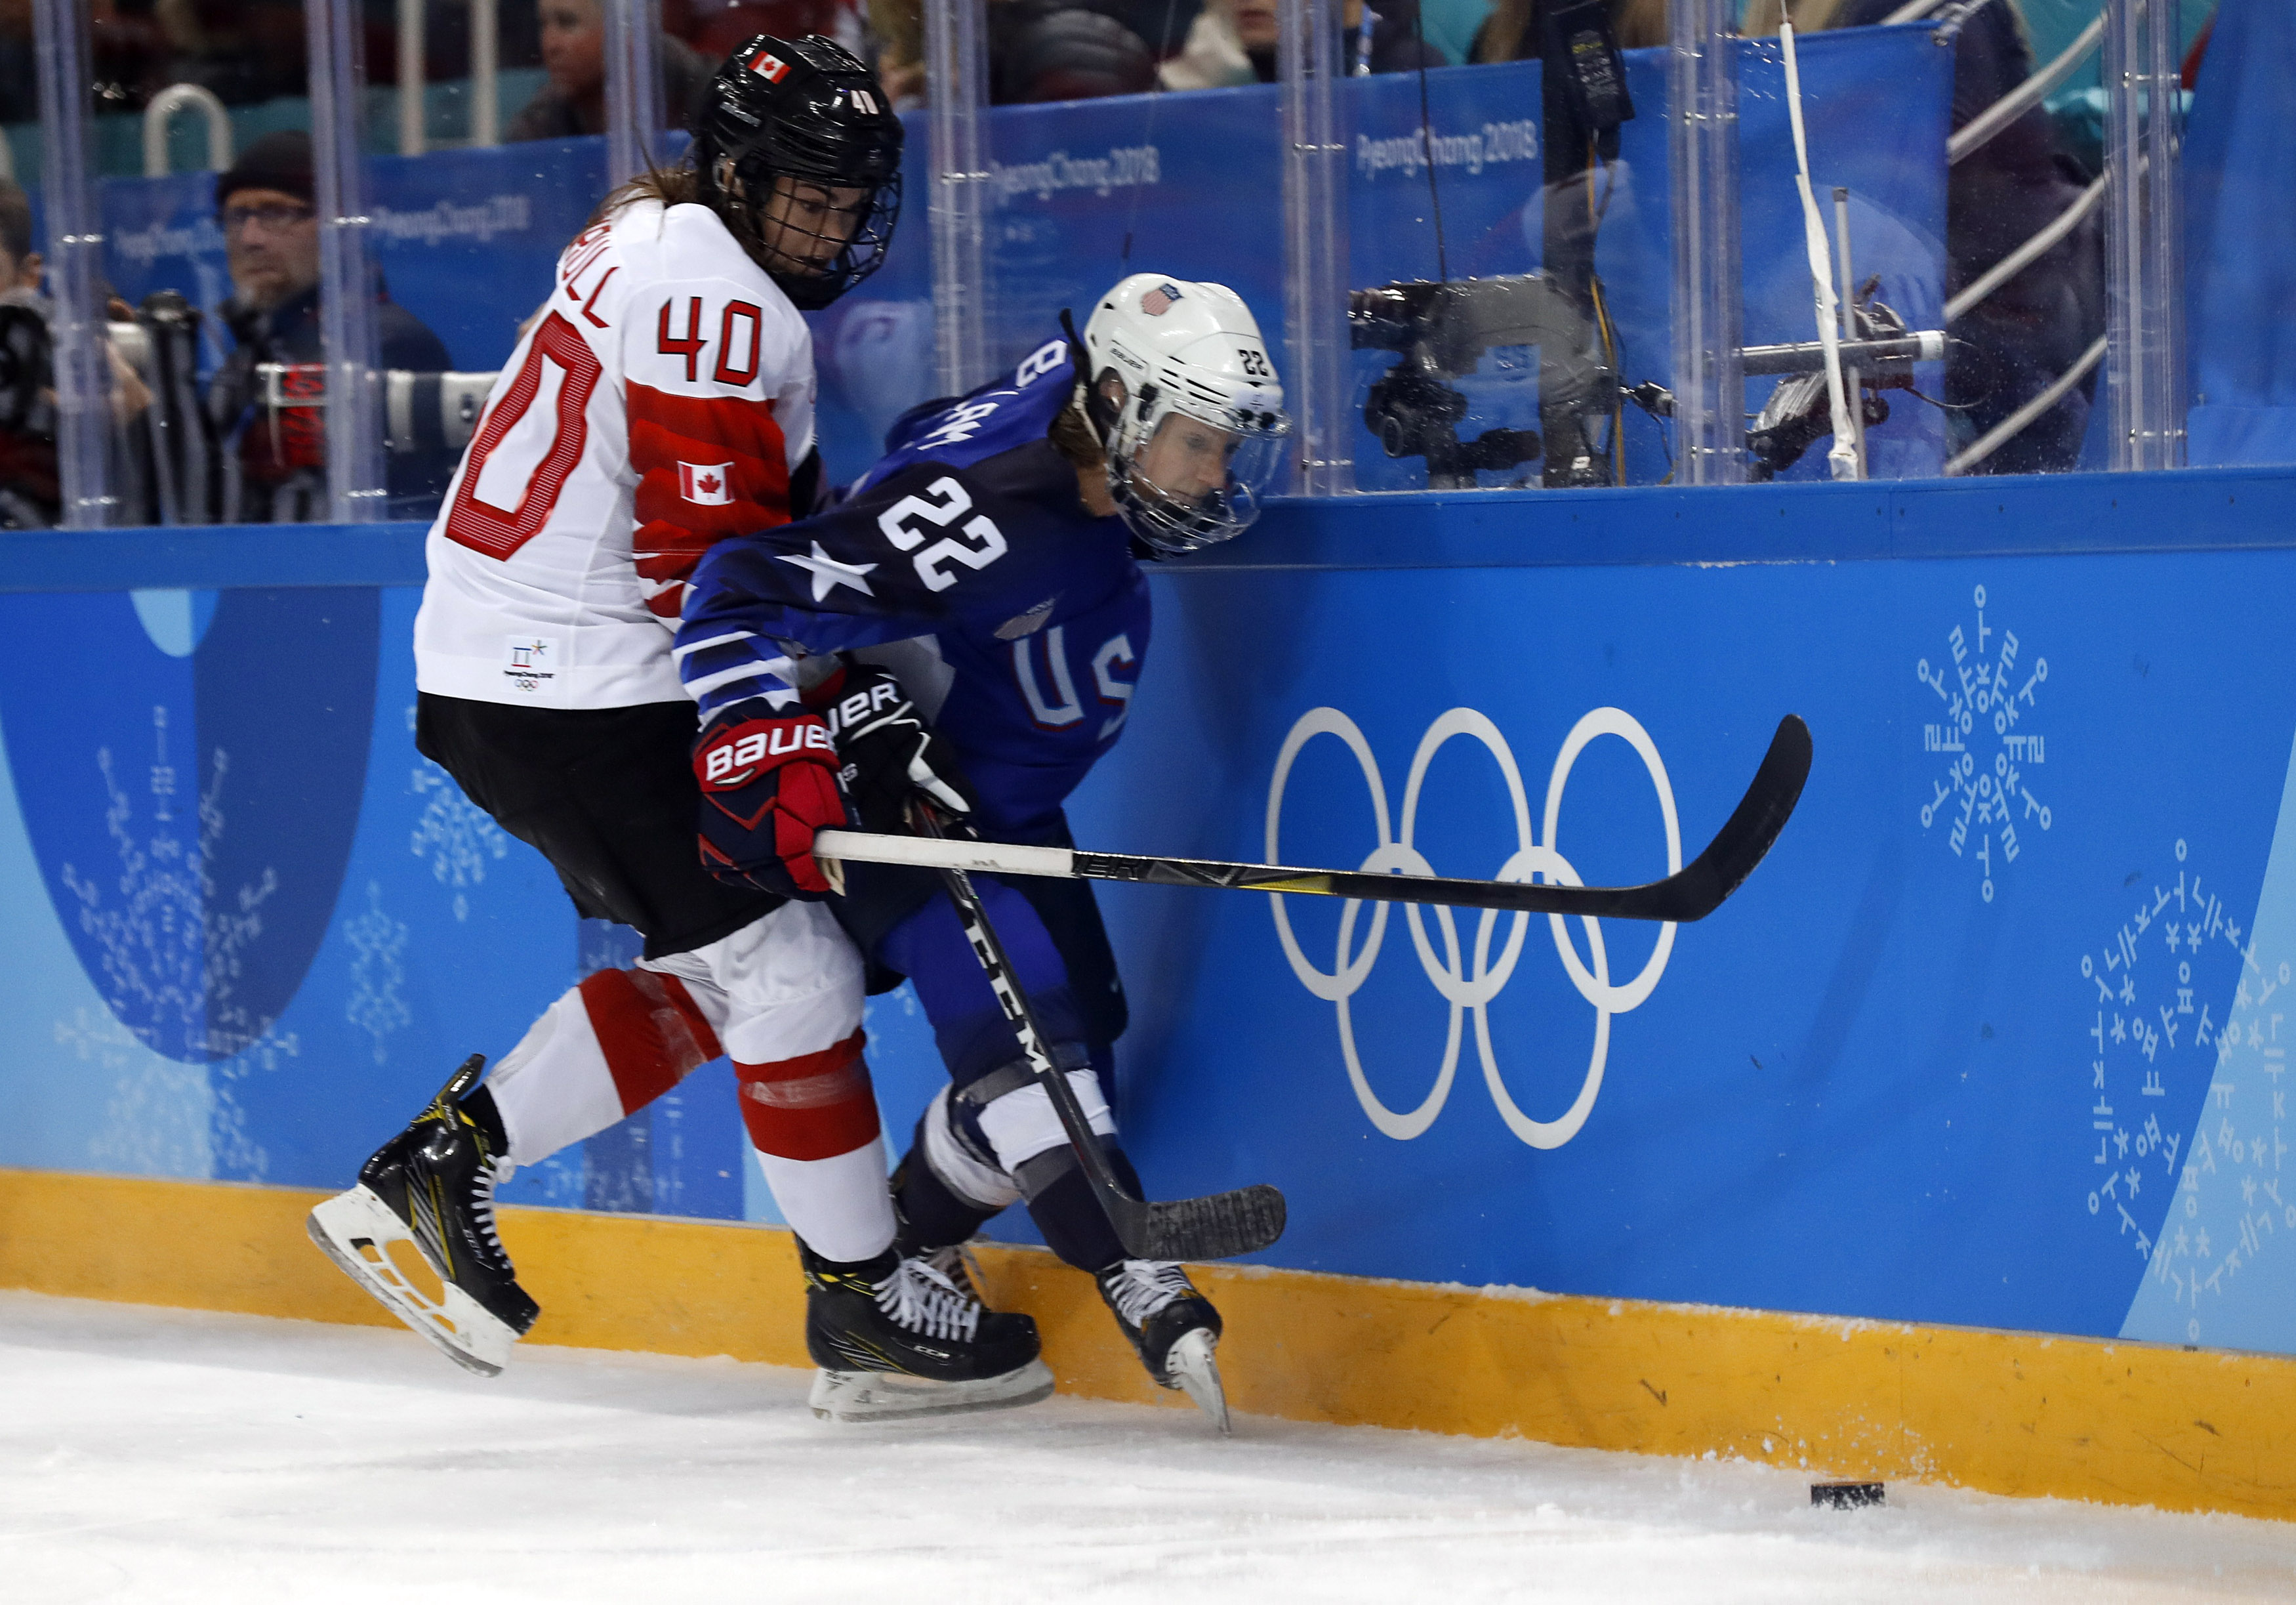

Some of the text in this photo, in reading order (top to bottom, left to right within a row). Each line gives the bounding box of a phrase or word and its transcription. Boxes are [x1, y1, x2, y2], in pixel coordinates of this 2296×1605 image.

[1356, 118, 1538, 182] PyeongChang 2018
[657, 295, 762, 388] 40
[1237, 348, 1270, 377] 22
[443, 308, 603, 562] 0
[876, 476, 1009, 593] 22
